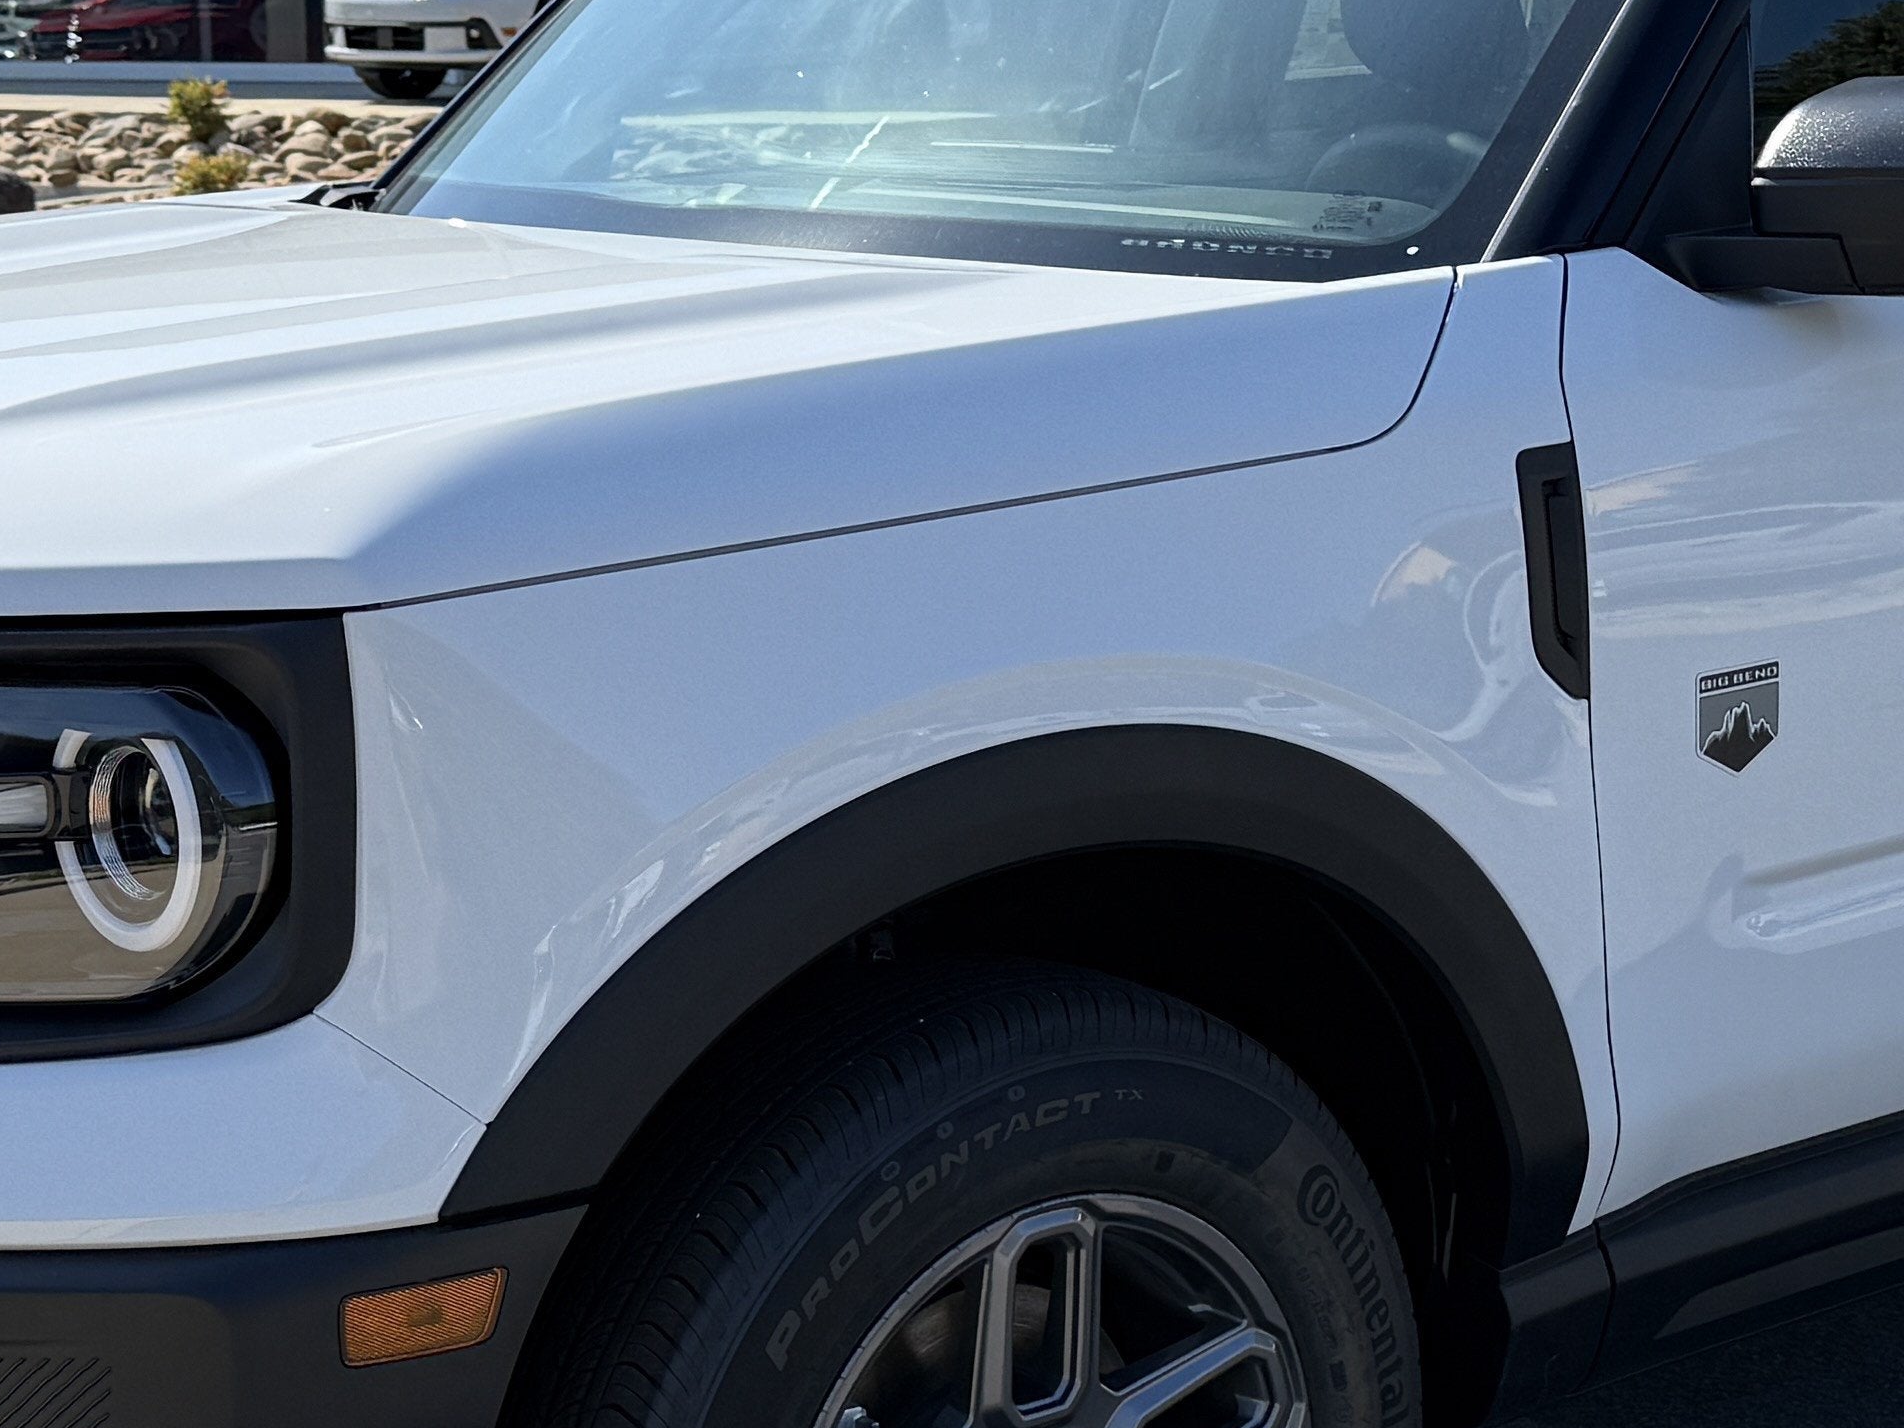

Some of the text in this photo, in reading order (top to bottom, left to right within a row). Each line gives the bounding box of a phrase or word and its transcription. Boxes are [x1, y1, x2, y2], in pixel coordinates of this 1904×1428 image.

[1701, 666, 1778, 691] BIG BEND
[1114, 1087, 1145, 1101] TX
[1295, 1163, 1412, 1428] Continental
